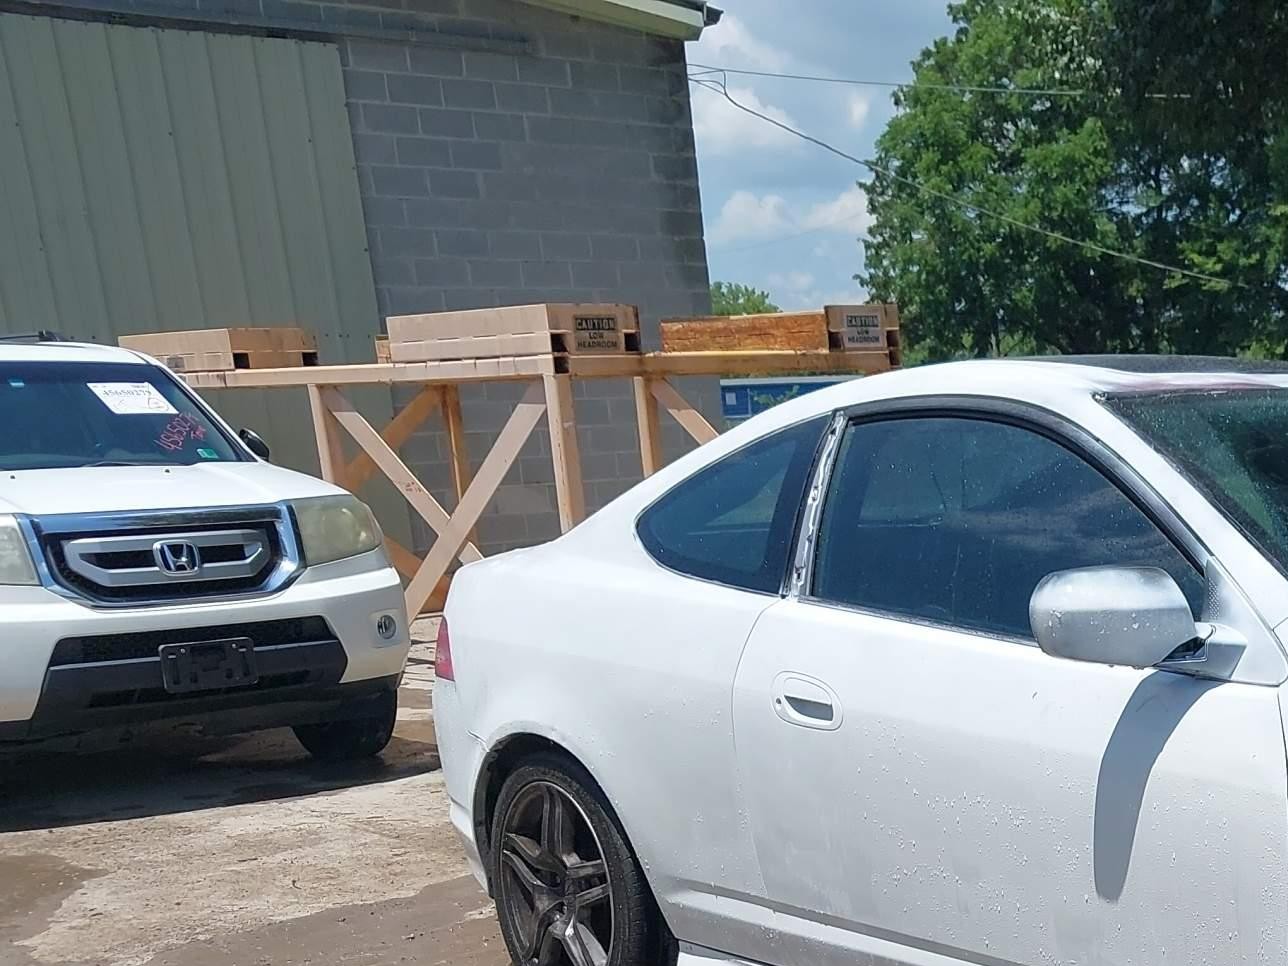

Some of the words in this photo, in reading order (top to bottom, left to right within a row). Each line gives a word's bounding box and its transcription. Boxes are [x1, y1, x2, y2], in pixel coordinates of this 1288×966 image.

[577, 318, 615, 329] CAUTION
[848, 316, 879, 326] CAUTION
[588, 332, 604, 340] LOW
